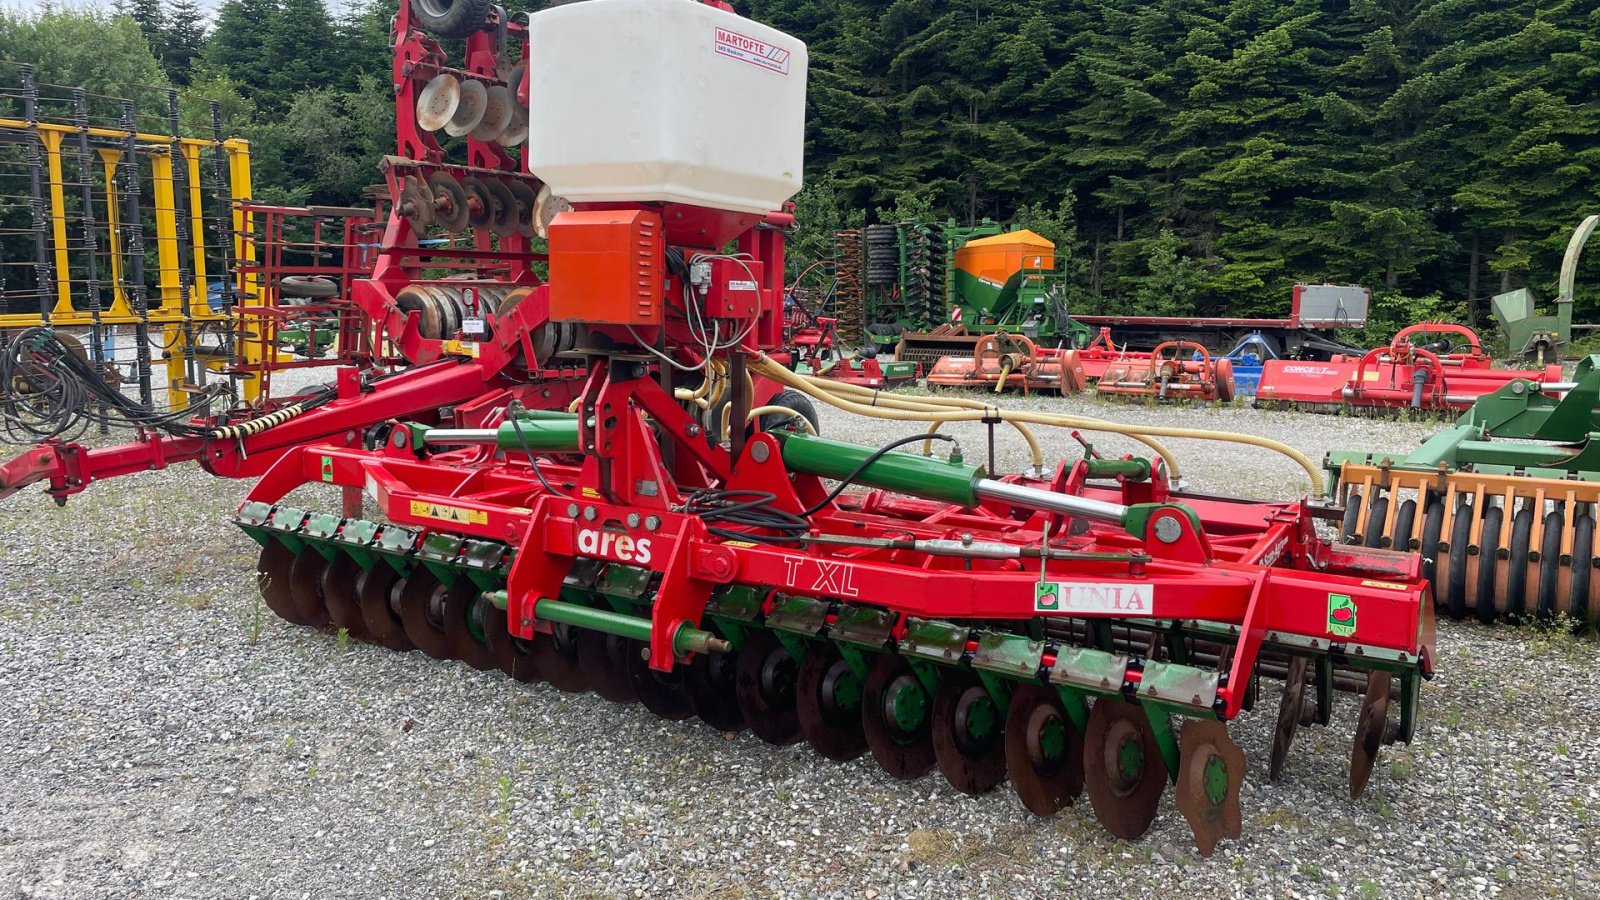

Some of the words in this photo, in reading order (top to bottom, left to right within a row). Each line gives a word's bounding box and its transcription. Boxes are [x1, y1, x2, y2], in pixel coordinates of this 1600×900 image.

[717, 31, 764, 54] MARTOFTE
[578, 529, 652, 564] ares
[784, 555, 804, 587] T
[811, 560, 859, 597] XL
[1063, 586, 1145, 610] UNIA
[1329, 624, 1354, 635] UNIA
